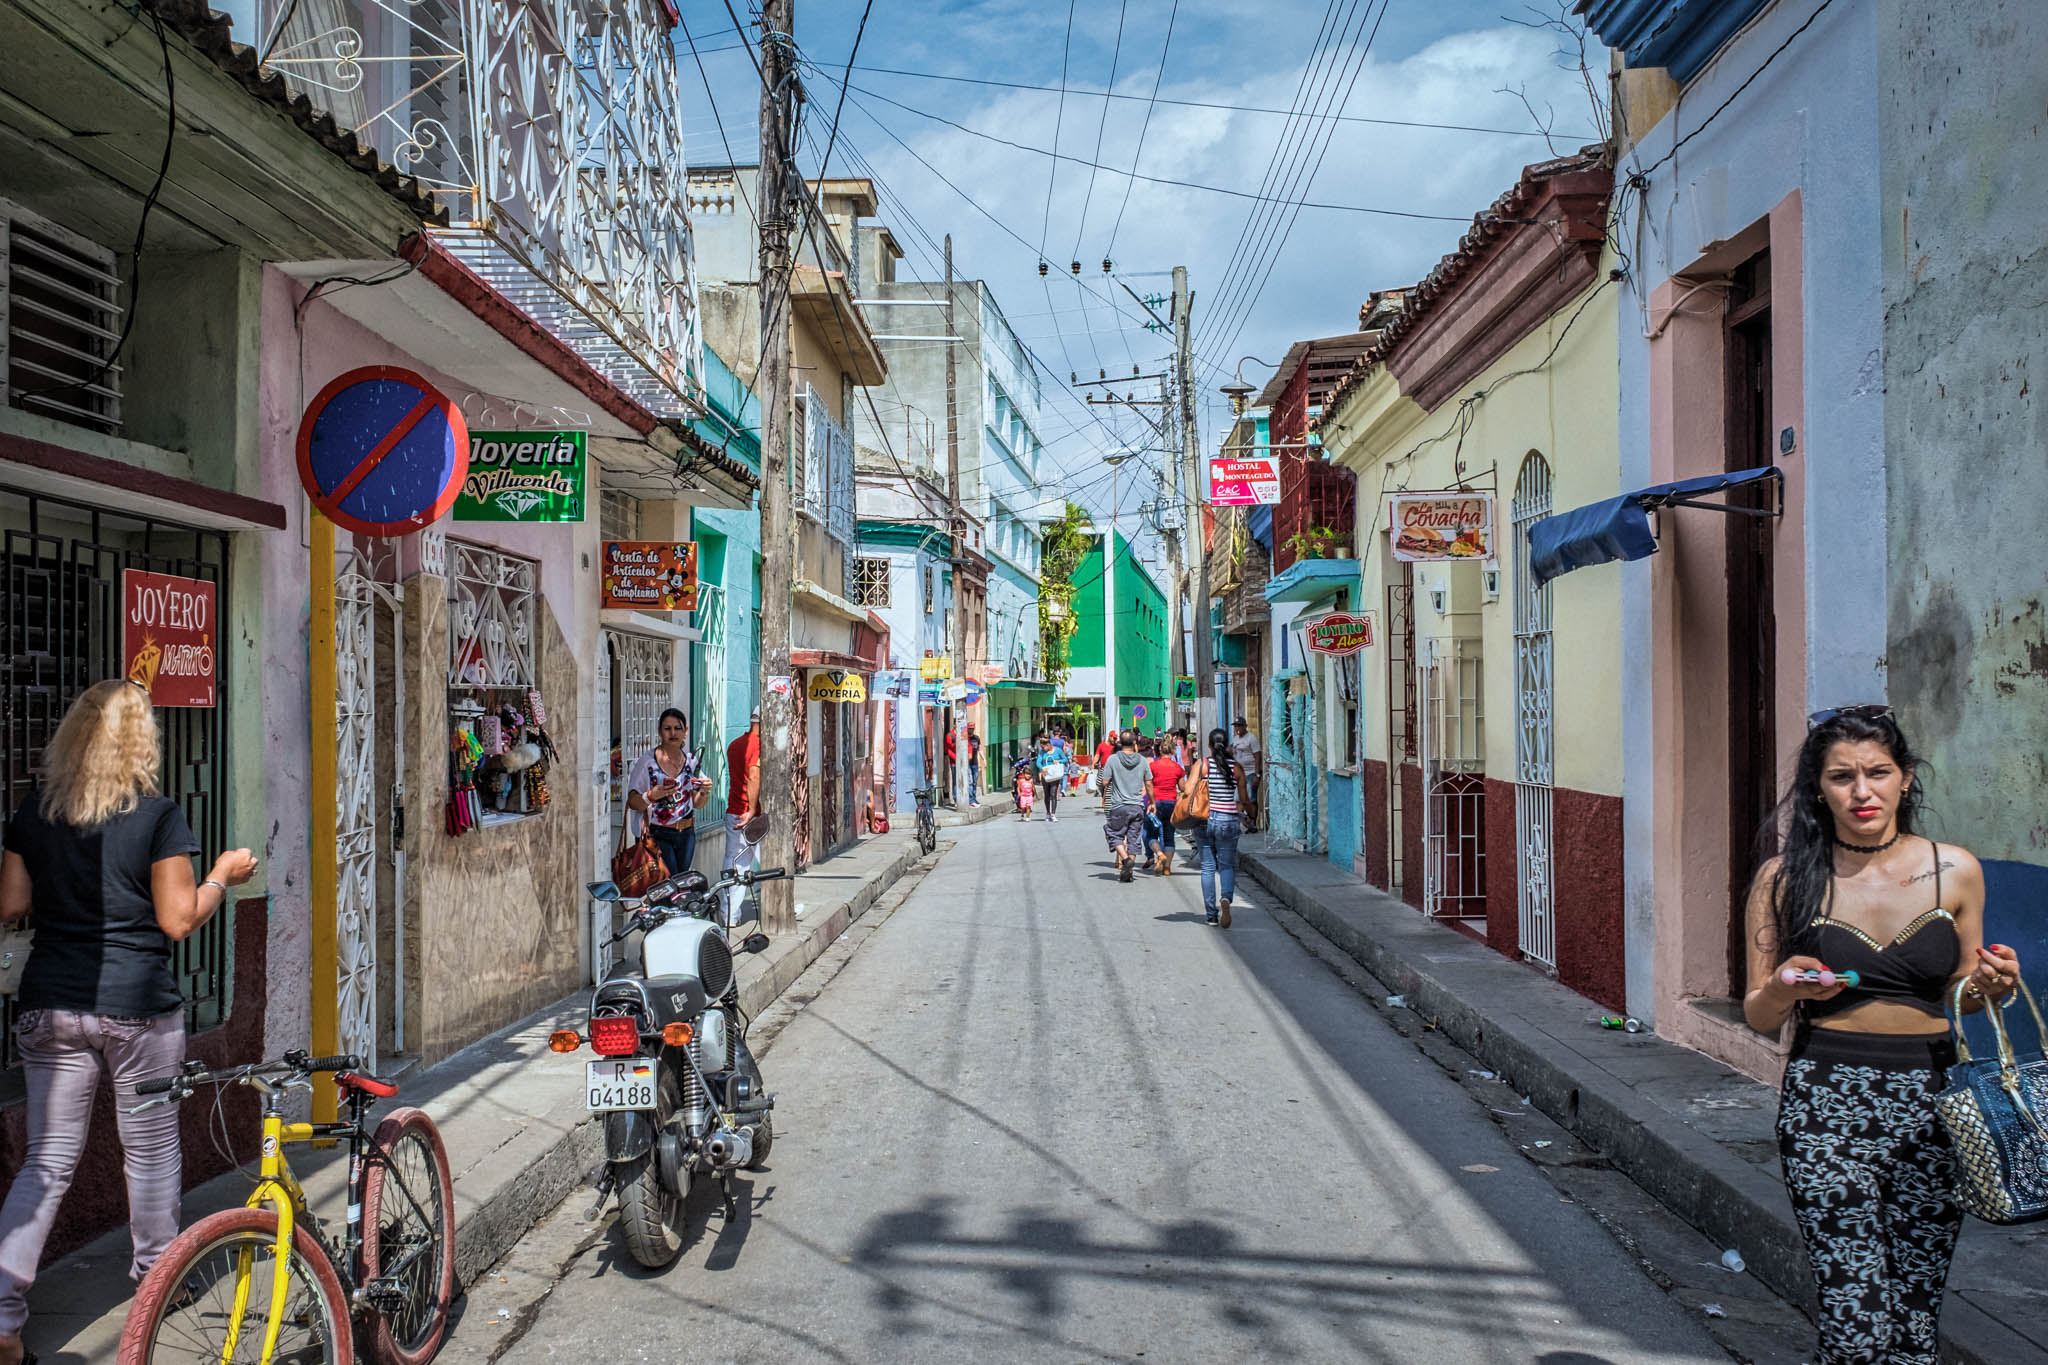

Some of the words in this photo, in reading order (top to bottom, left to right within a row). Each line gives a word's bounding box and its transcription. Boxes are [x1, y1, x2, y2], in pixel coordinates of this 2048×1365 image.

[469, 435, 575, 468] Joyería
[1227, 463, 1261, 471] HOSTAL
[1225, 472, 1274, 480] MONTEAGUDO
[466, 470, 569, 501] Villuenda
[1216, 484, 1241, 494] C&C
[1403, 500, 1482, 527] Covacha
[612, 550, 643, 562] Venta
[647, 550, 660, 562] de
[621, 576, 632, 587] de
[612, 585, 660, 602] Cumpleaños
[131, 583, 207, 631] JOYERO
[1316, 623, 1364, 638] JOYERO
[1336, 635, 1366, 649] Alex
[615, 1063, 626, 1082] R
[590, 1086, 651, 1107] 04188
